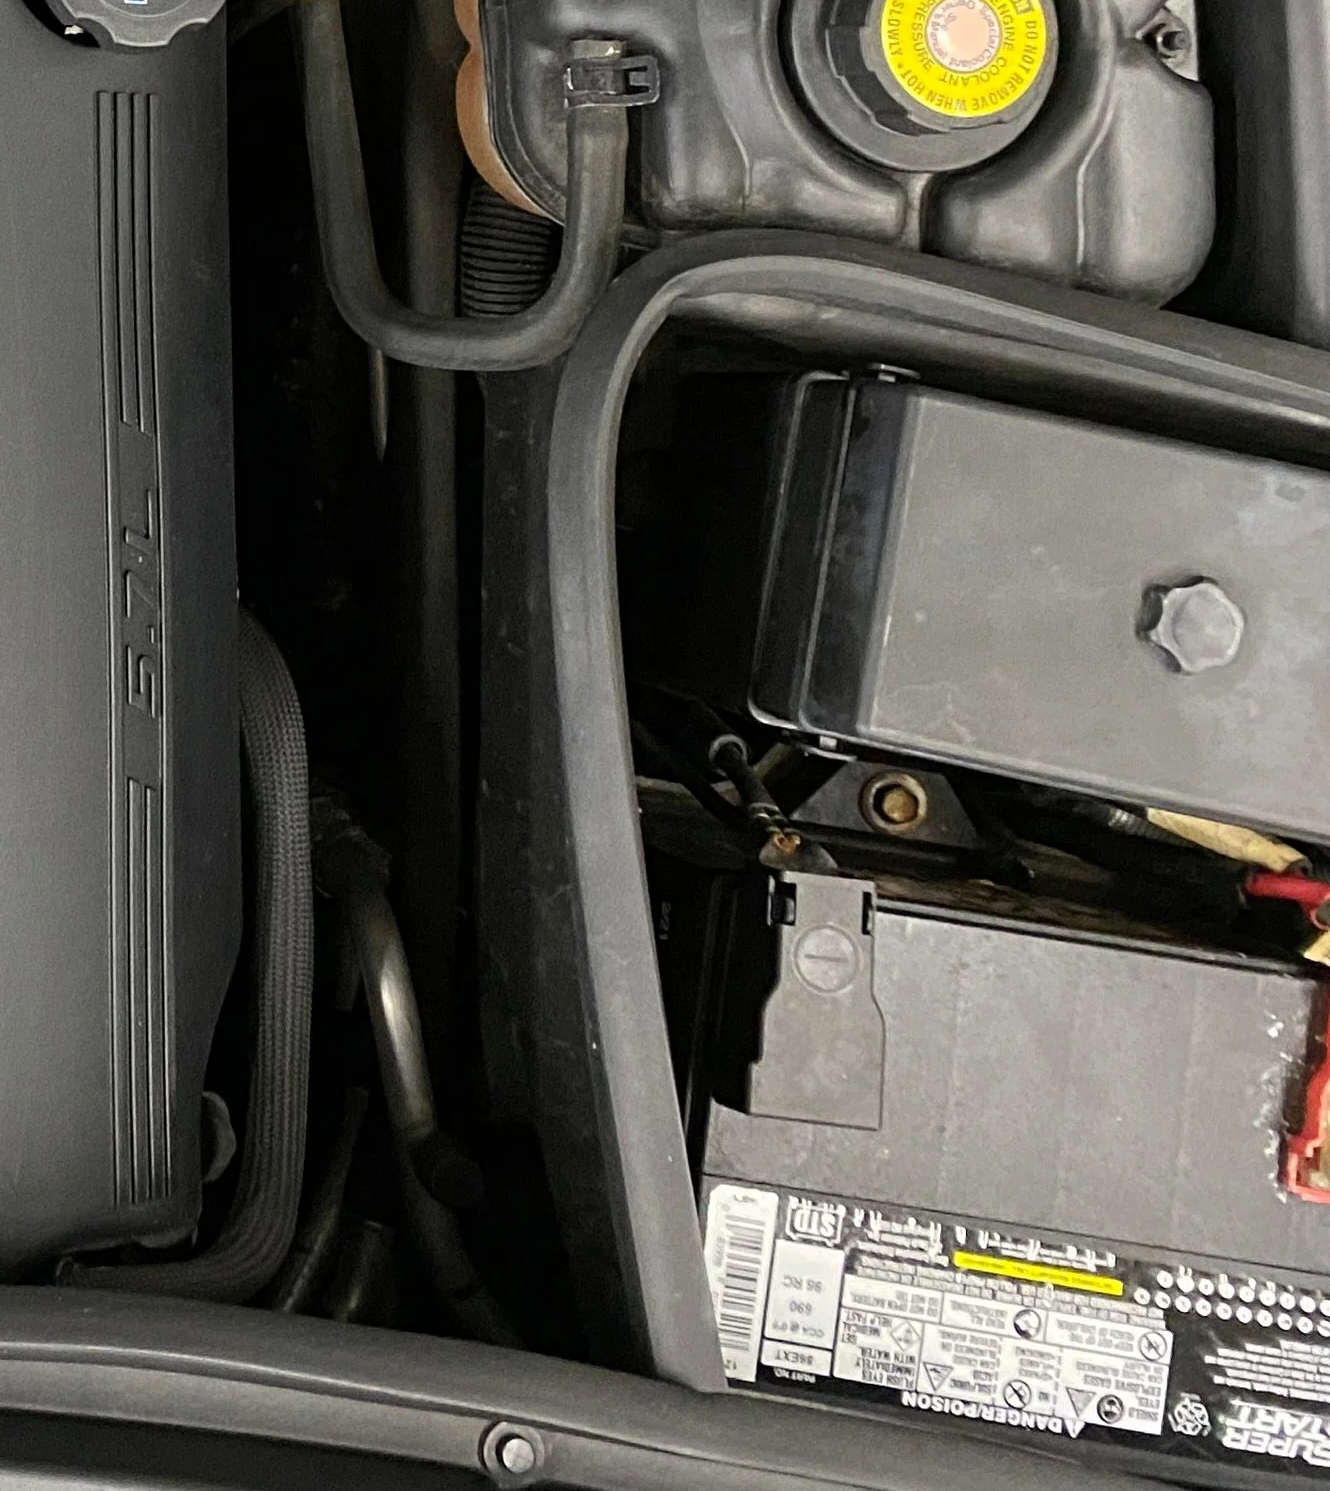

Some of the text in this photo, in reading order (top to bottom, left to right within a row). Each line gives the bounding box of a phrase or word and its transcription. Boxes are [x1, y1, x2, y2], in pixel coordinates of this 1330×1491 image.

[887, 0, 905, 56] SLOWLY
[899, 20, 1040, 112] DO NOT REMOVE WHEN HOT
[938, 56, 1007, 87] COOLANT
[899, 1391, 1064, 1432] DANGER/POISON
[1223, 1404, 1330, 1441] TART
